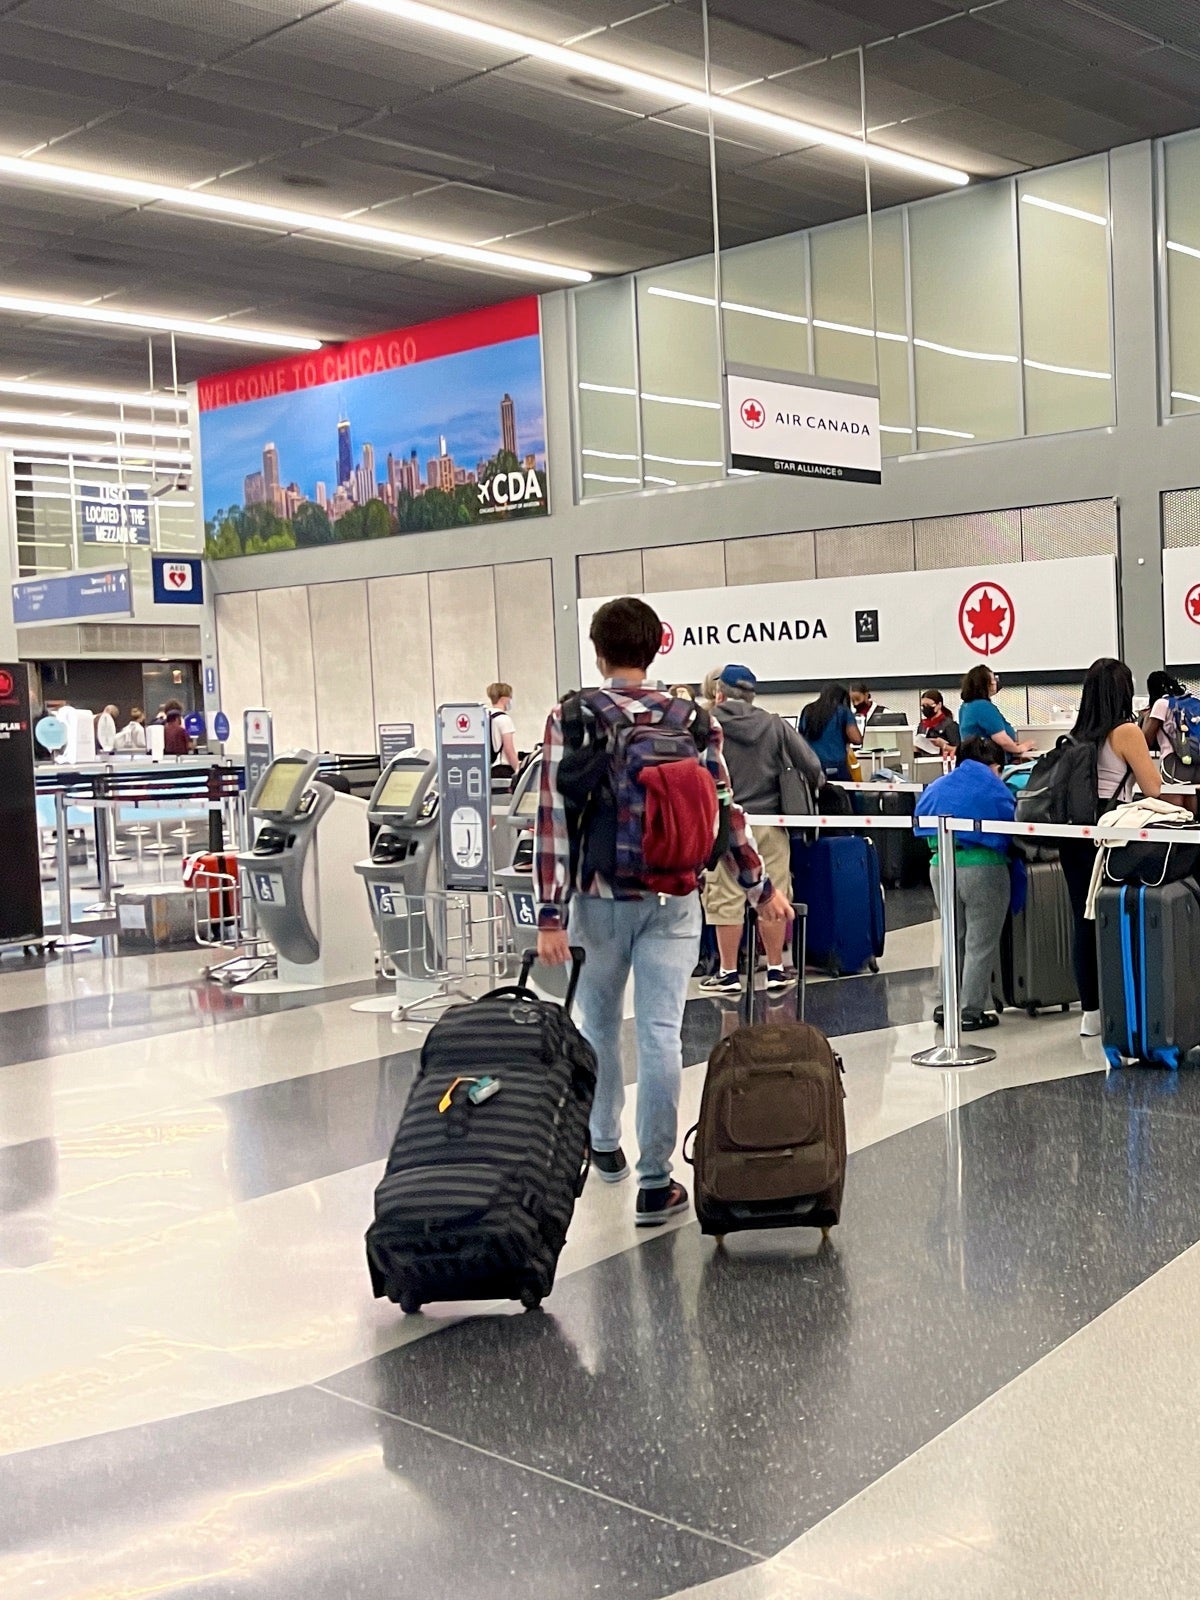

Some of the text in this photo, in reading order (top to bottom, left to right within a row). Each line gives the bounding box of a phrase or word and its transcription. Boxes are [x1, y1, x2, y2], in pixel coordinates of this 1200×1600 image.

[199, 336, 417, 412] WELCOME TO CHICAGO
[775, 412, 871, 436] AIR CANADA
[774, 460, 837, 476] STAR ALLIANCE
[492, 468, 543, 504] CDA
[85, 505, 120, 524] LOCATED
[129, 508, 146, 526] THE
[682, 618, 828, 647] AIR CANADA
[0, 722, 21, 731] PLAN
